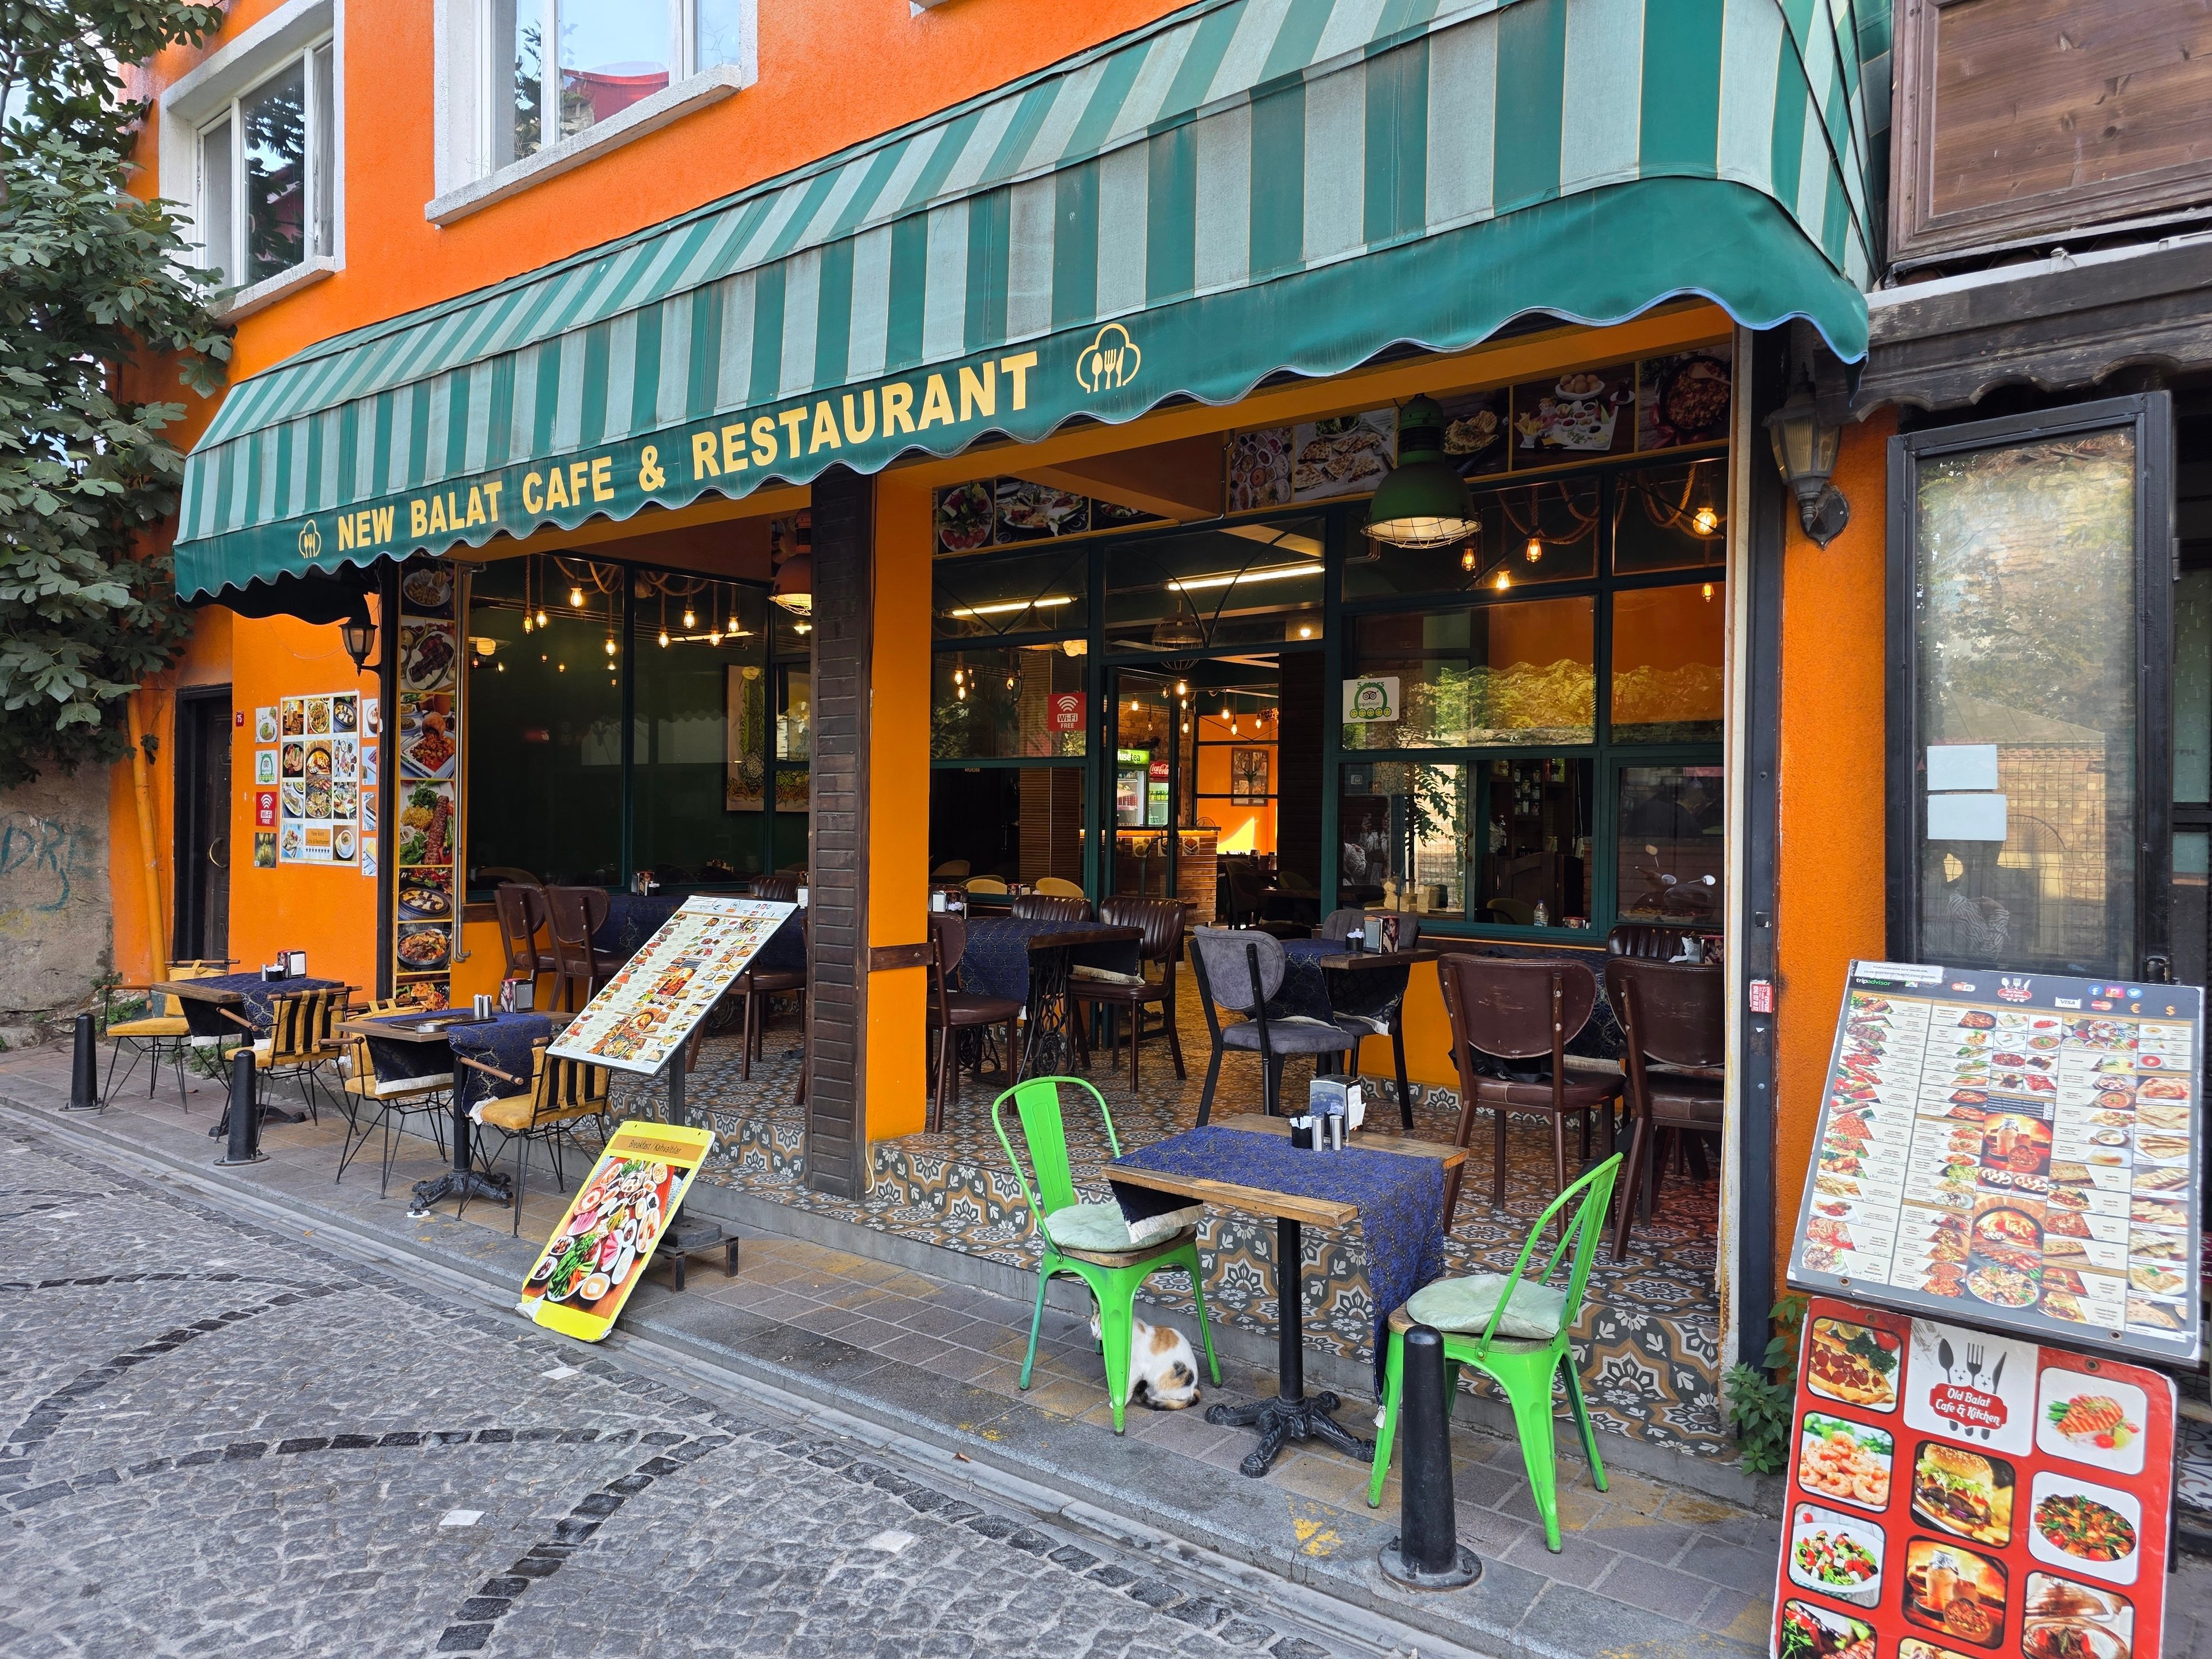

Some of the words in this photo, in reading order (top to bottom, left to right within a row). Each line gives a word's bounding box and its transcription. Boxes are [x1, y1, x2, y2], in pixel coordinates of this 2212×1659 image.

[338, 506, 394, 550] NEW
[411, 481, 502, 537] BALAT
[522, 456, 614, 514] CAFE
[639, 445, 665, 491] &
[692, 351, 1037, 480] RESTAURANT
[1856, 978, 1891, 986] tripadvisor
[628, 1139, 651, 1150] Breakfast
[654, 1143, 681, 1154] Kahvaltılar
[1948, 1387, 1964, 1400] Old
[1965, 1392, 1991, 1407] Balat
[1935, 1399, 1955, 1414] Cafe
[1956, 1403, 1965, 1418] &
[1967, 1406, 2001, 1427] Kitchen
